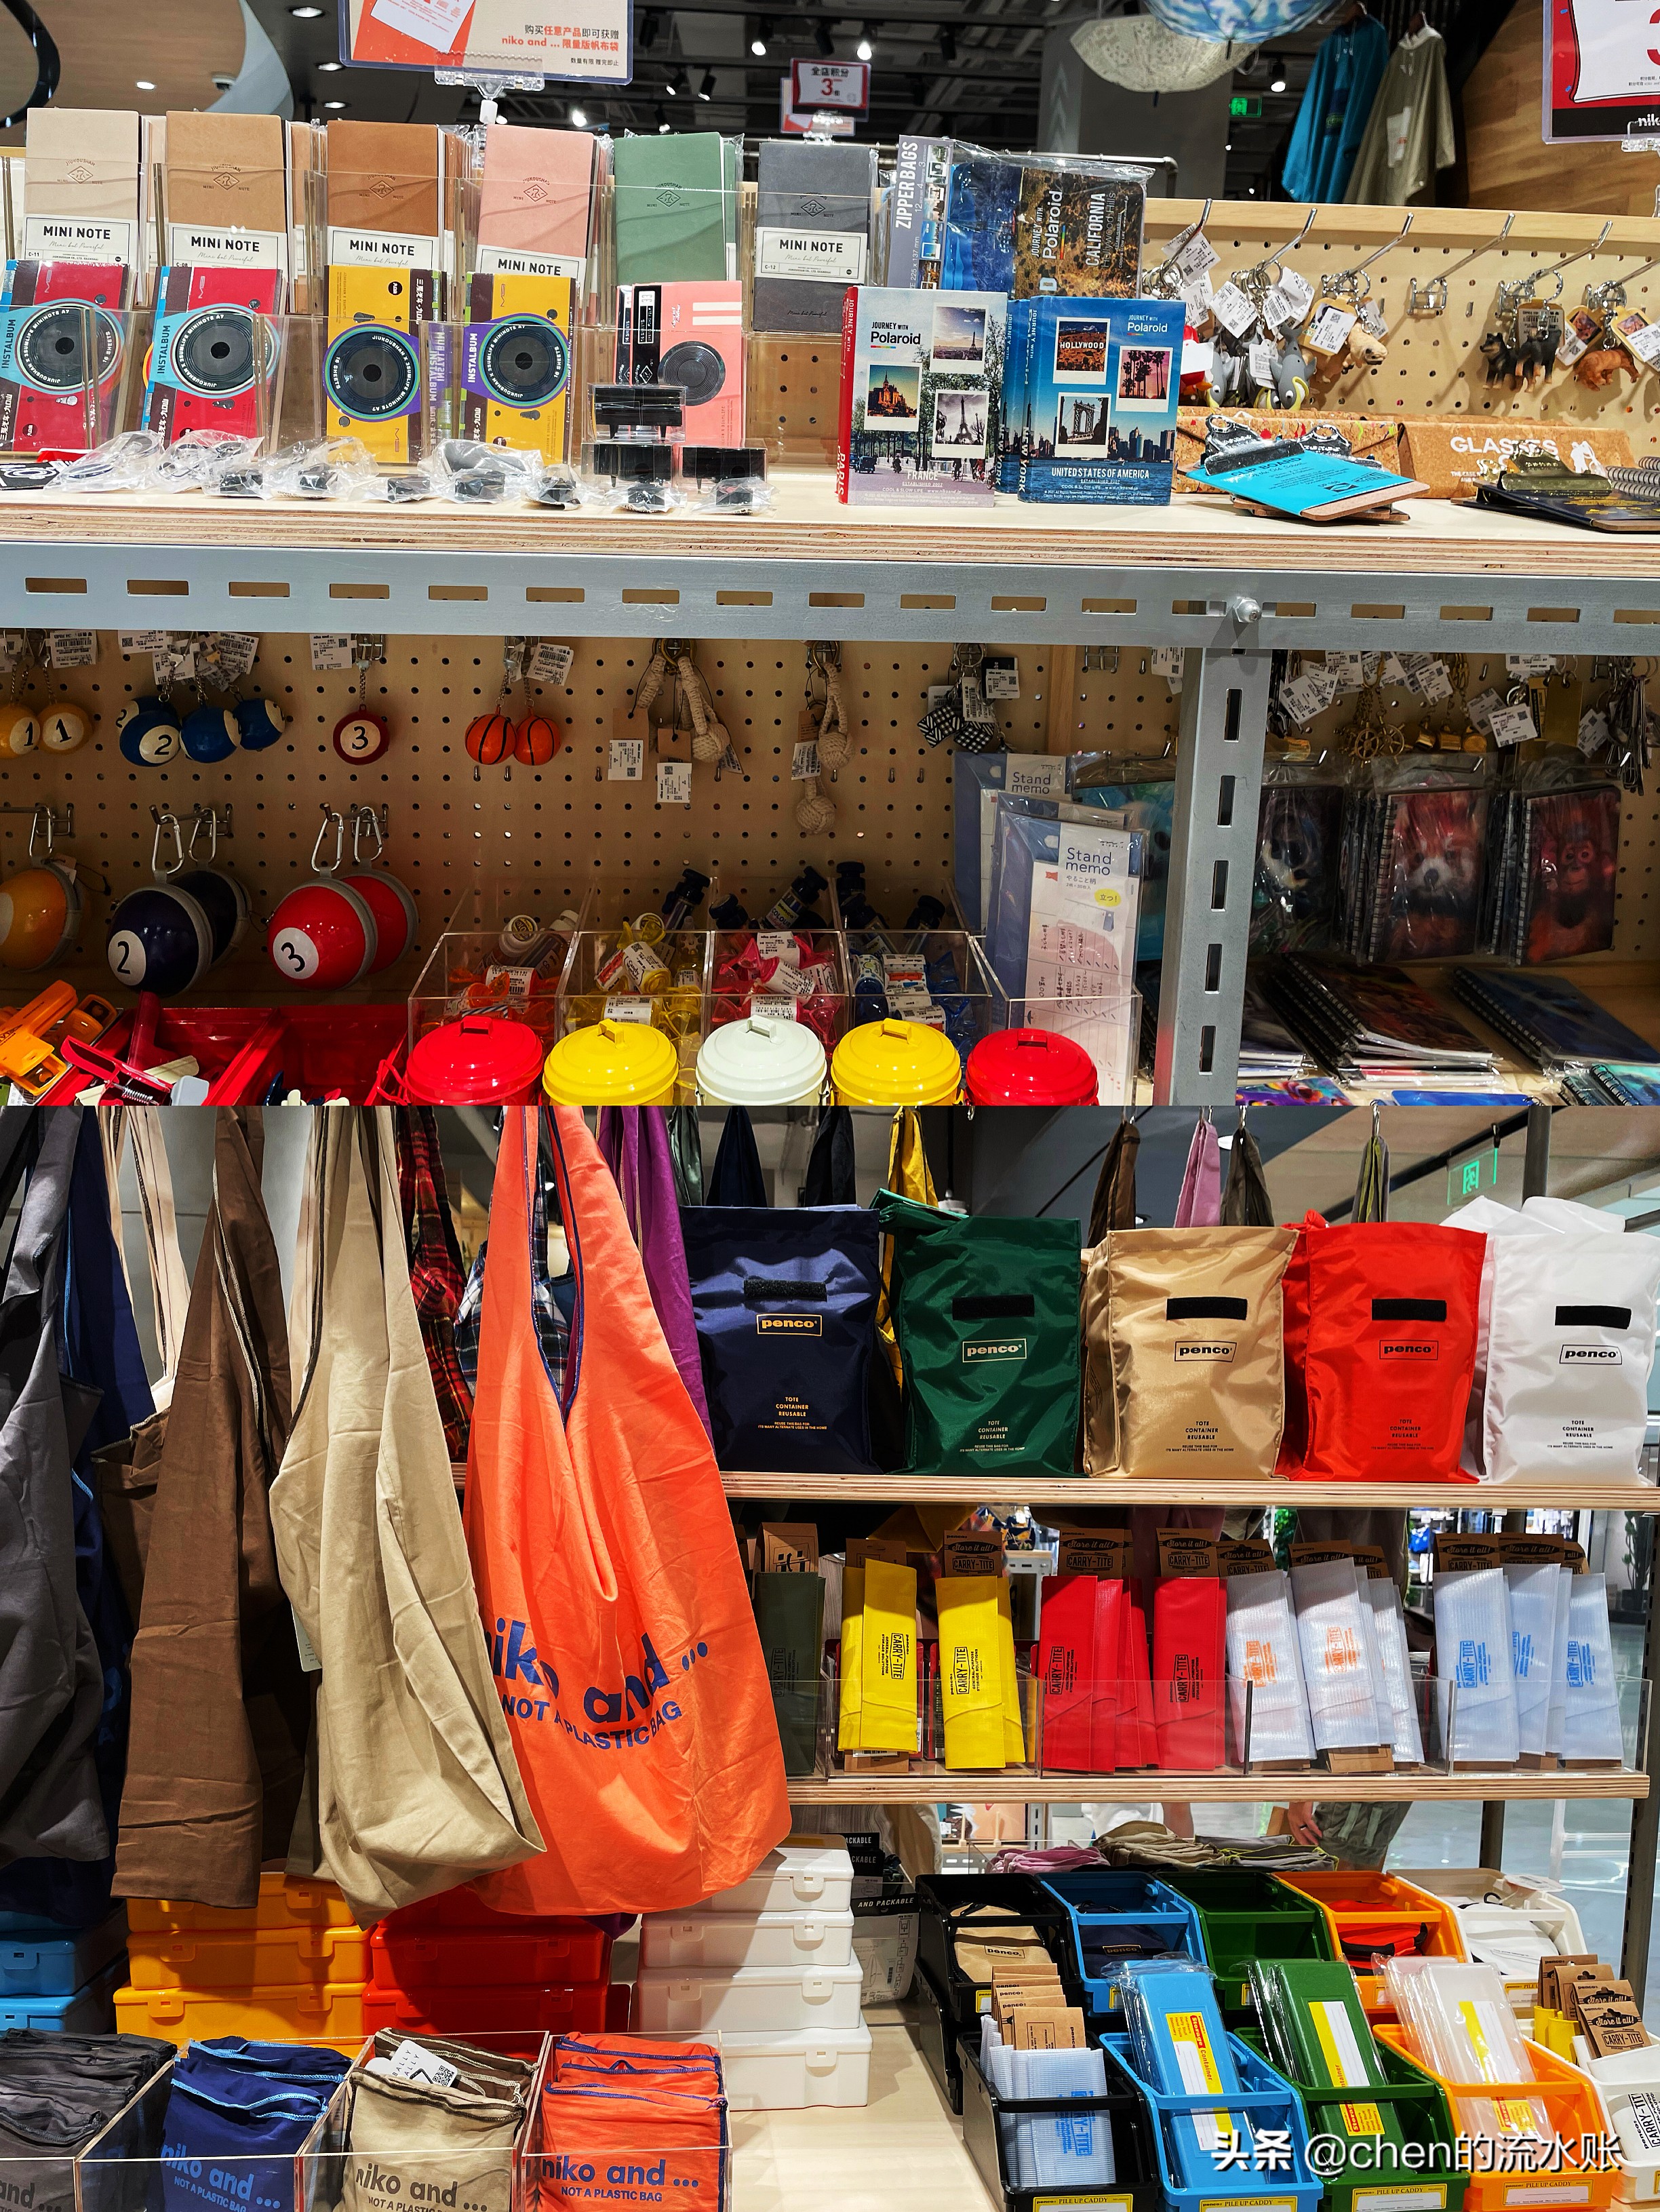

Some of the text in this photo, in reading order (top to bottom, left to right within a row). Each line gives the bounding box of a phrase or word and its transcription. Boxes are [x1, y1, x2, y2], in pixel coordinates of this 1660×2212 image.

[525, 24, 619, 39] 购买任意产品即可获赠
[1638, 113, 1660, 127] nik
[895, 141, 918, 229] ZIPPER BAGS
[43, 226, 111, 239] MINI NOTE
[1042, 191, 1063, 259] Polaroid
[1085, 193, 1105, 266] CALIFORNIA
[1101, 193, 1115, 267] Hollywood Hills
[191, 236, 260, 252] MINI NOTE
[349, 239, 415, 256] MINI NOTE
[779, 239, 843, 253] MINI NOTE
[1031, 224, 1042, 257] JOURNEY
[498, 258, 561, 276] MINI NOTE
[494, 325, 517, 343] MININOTE
[871, 321, 897, 330] JOURNEY
[1128, 322, 1167, 332] Polaroid
[1, 319, 16, 369] INSTALBUM
[871, 331, 921, 345] Polaroid
[157, 325, 171, 374] INSTALBUM
[468, 333, 477, 383] INSTALBUM
[333, 364, 341, 389] SHEETS
[492, 378, 523, 398] JIUKOUSHAN
[1259, 456, 1302, 470] BOARD
[907, 471, 938, 481] FRANCE
[1019, 460, 1027, 492] YORK
[1052, 467, 1149, 479] UNITED STATES OF AMERICA
[25, 722, 34, 746] 1
[55, 719, 72, 742] 1
[351, 726, 368, 750] 3
[155, 734, 172, 755] 2
[1013, 772, 1051, 785] Stand
[1012, 783, 1050, 794] memo
[1067, 848, 1111, 865] Stand
[1065, 863, 1110, 875] memo
[1067, 875, 1096, 884] やること柄
[771, 908, 793, 928] COLOUR
[117, 941, 131, 974] 2
[281, 941, 305, 972] 3
[1067, 1539, 1089, 1549] Store
[1098, 1540, 1114, 1549] all!
[953, 1558, 994, 1571] CARRY-TITE
[1068, 1555, 1112, 1567] CARRY-TITE
[1168, 1554, 1209, 1566] CARRY-TITE
[583, 1632, 670, 1723] and
[1176, 1655, 1187, 1702] CARRY-TITE
[502, 1695, 681, 1750] NOT A PLASTIC BAG
[852, 1855, 876, 1863] CKABLE
[877, 1897, 914, 1906] PACKABLE
[1596, 2017, 1615, 2026] Store
[1192, 2017, 1212, 2080] Storage Container
[1604, 2034, 1642, 2045] CARRY-TITE
[1335, 2065, 1345, 2087] ntainer
[161, 2143, 202, 2178] niko
[209, 2168, 254, 2200] and
[544, 2155, 594, 2181] niko
[608, 2159, 665, 2186] and
[174, 2176, 247, 2212] NOT A PLASTIC BAG
[356, 2163, 401, 2194] niko
[410, 2181, 458, 2208] and
[561, 2186, 663, 2202] NOT A PLASTIC BAG
